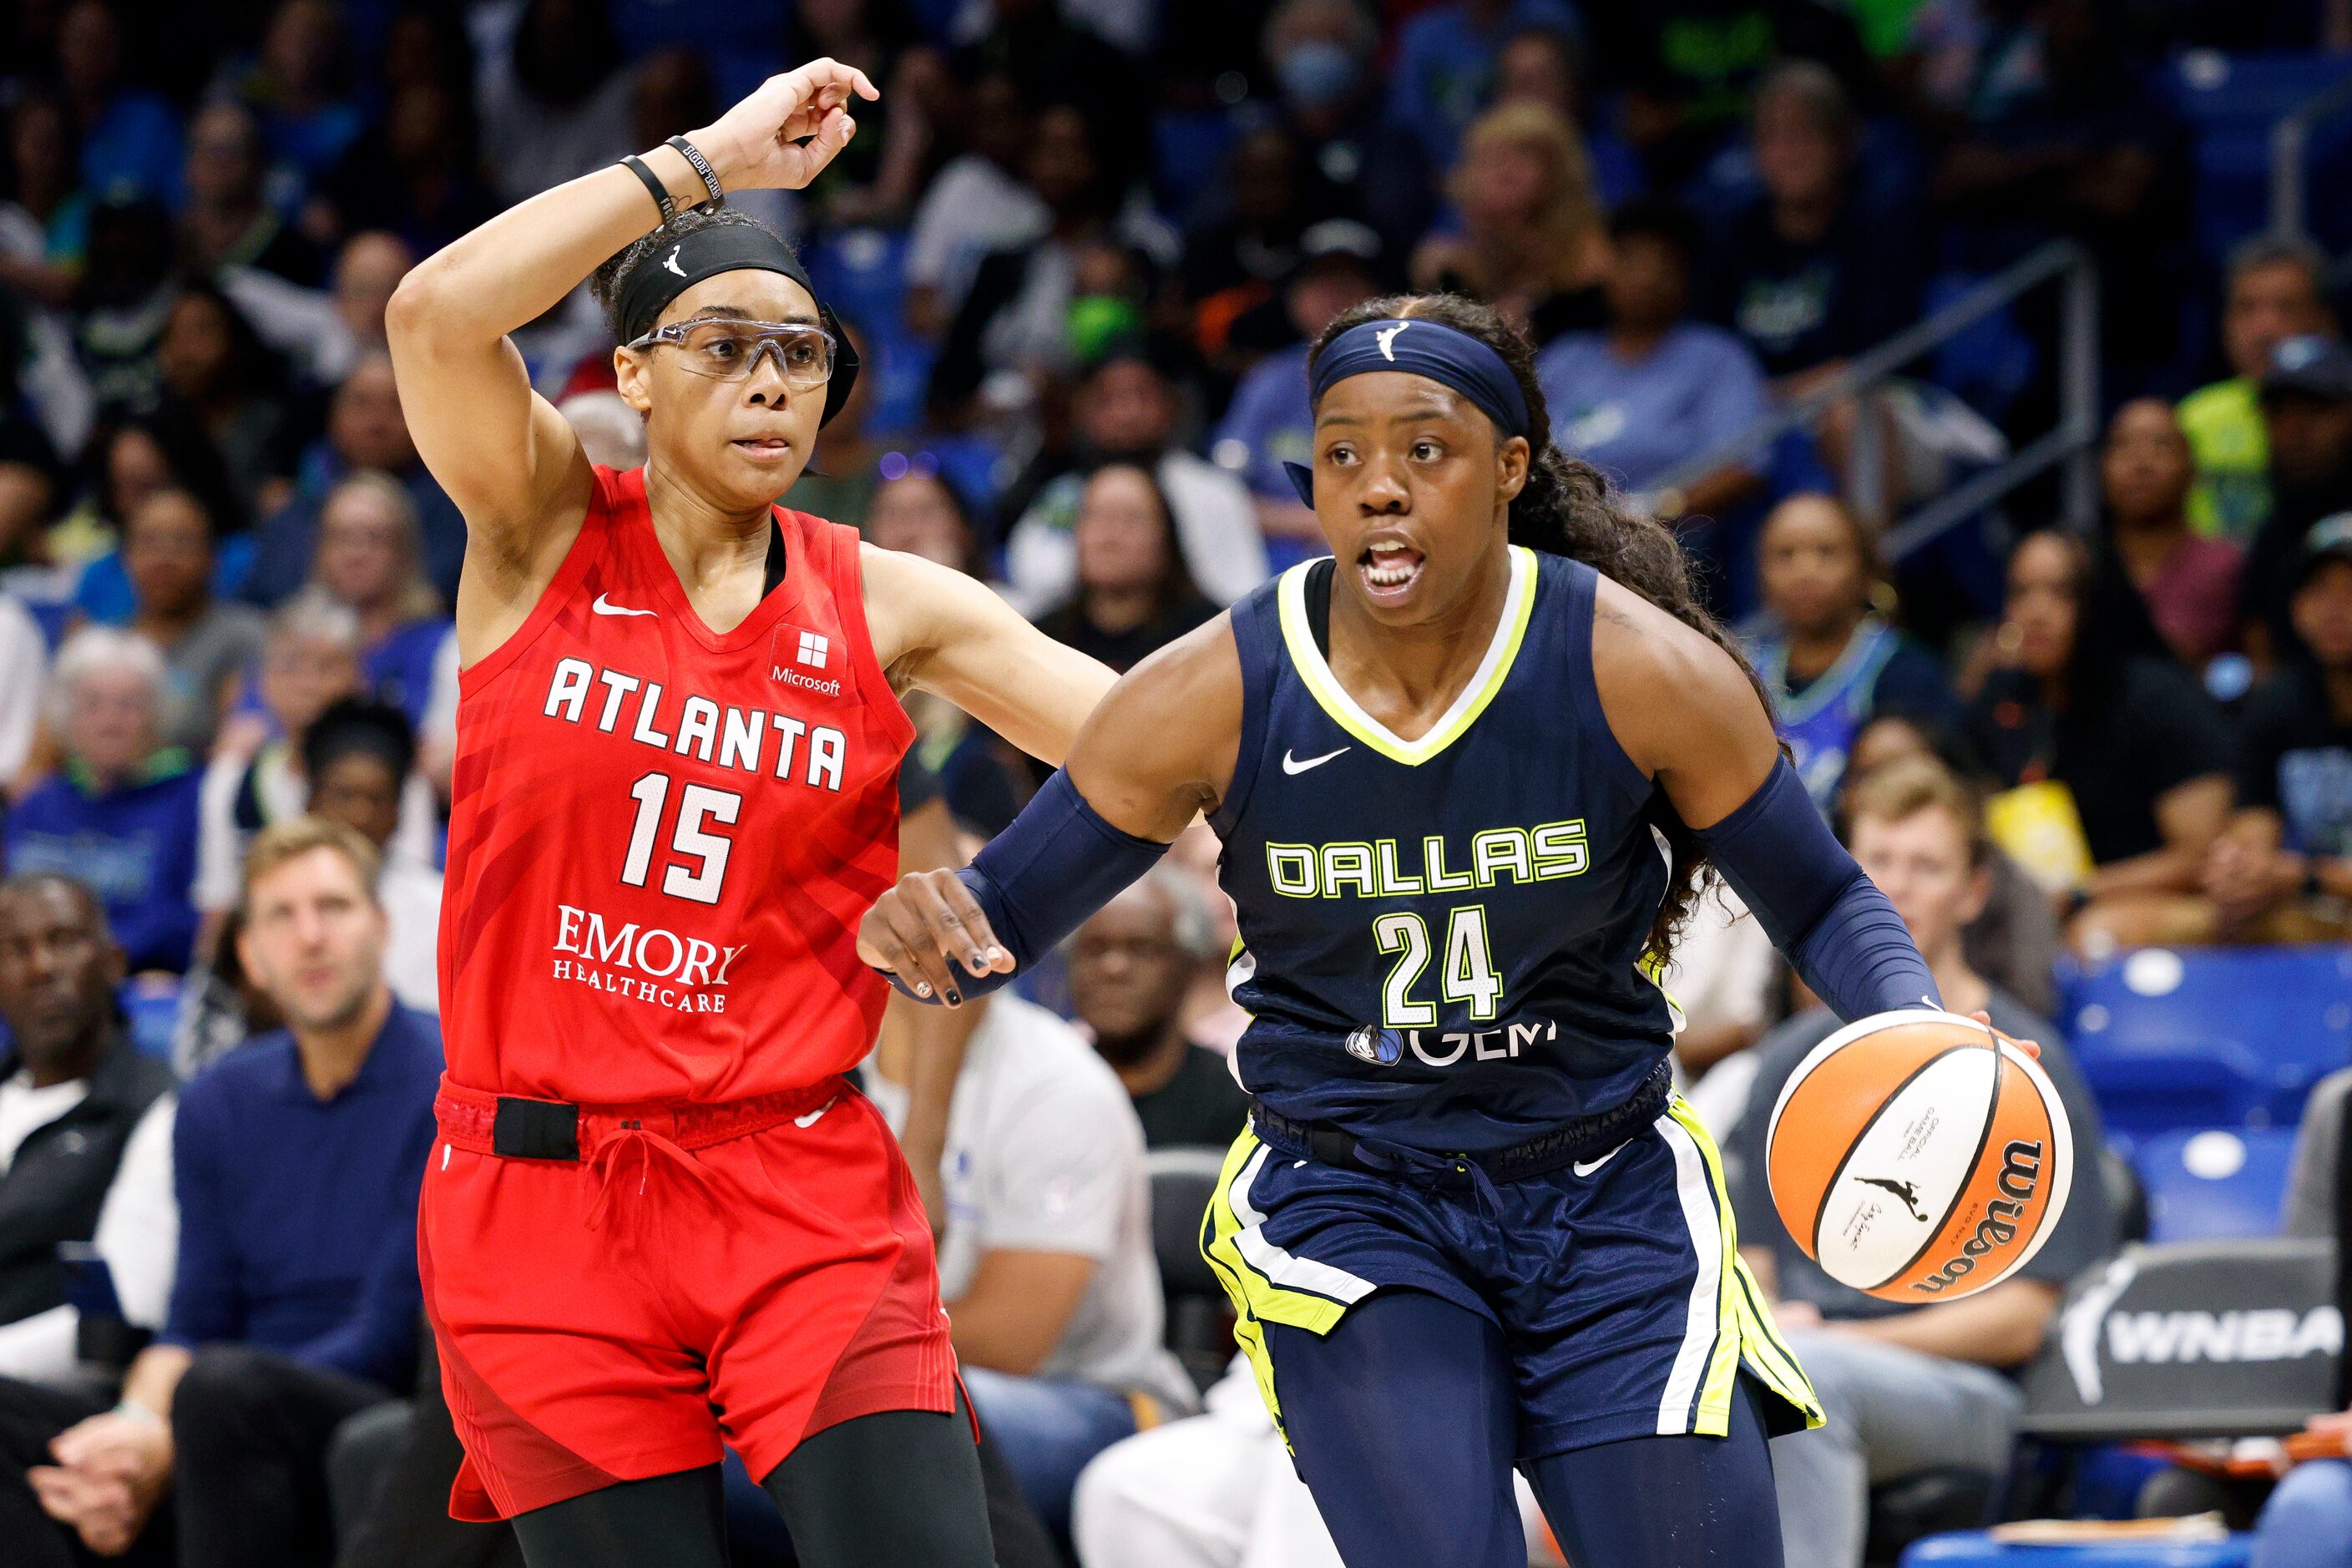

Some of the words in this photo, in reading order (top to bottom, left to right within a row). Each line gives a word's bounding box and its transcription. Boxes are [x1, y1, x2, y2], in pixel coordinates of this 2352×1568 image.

[682, 145, 695, 156] I
[689, 151, 710, 175] GOT
[704, 171, 722, 200] THIS
[772, 665, 841, 696] Microsoft
[543, 656, 847, 792] ATLANTA
[620, 771, 743, 906] 15
[1266, 817, 1590, 899] DALLAS
[553, 904, 748, 986] EMORY
[1372, 904, 1504, 1029] 24
[553, 959, 726, 1014] HEALTHCARE
[1897, 1136, 1917, 1161] BALL
[1909, 1117, 1940, 1159] OFFICIAL
[1914, 1107, 1935, 1136] GAME
[1908, 1139, 2043, 1294] Wilson
[2106, 1304, 2346, 1364] WNBA
